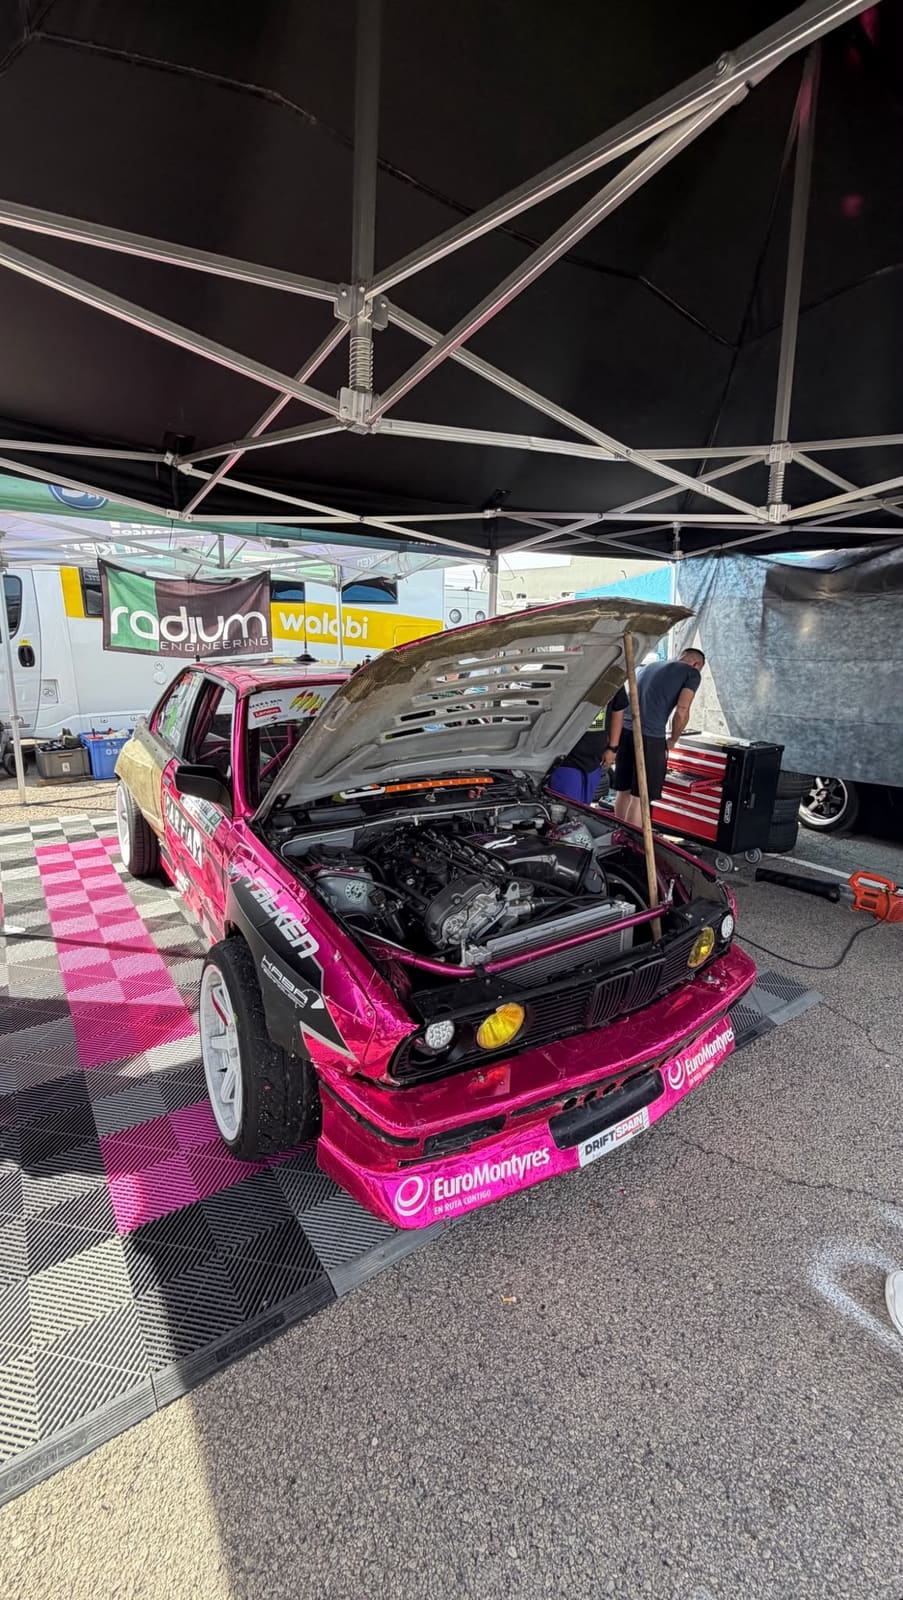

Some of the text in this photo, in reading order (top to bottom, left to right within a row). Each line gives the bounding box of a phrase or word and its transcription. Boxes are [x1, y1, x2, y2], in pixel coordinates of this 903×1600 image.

[111, 606, 267, 643] radium
[280, 612, 368, 640] walabi
[160, 637, 269, 652] ENGINEERING
[245, 876, 320, 959] FALKEN
[685, 1027, 735, 1076] EuroMontyres
[433, 1148, 550, 1202] EuroMontyres
[434, 1189, 492, 1215] EN RUTA CONTIGO
